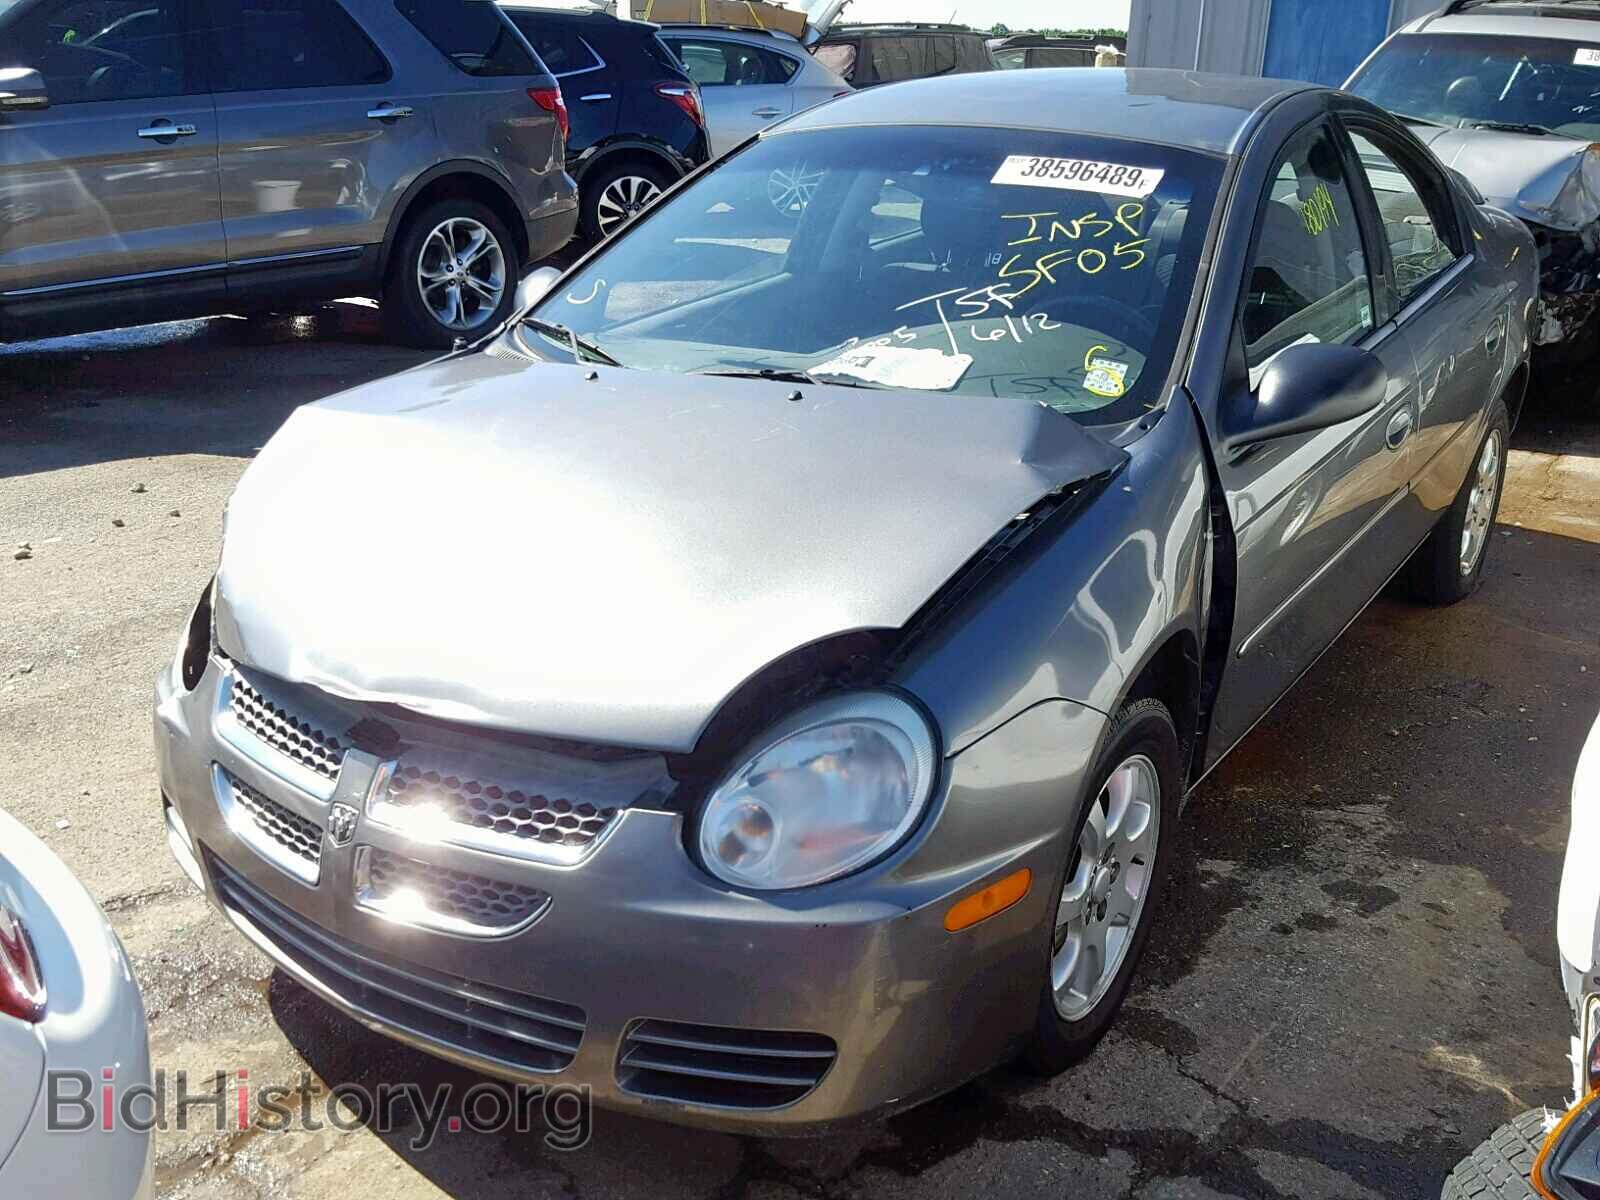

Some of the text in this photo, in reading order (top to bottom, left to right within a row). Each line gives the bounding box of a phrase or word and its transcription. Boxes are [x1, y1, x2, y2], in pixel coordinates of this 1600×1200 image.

[1020, 157, 1143, 188] 38596489
[1000, 202, 1144, 246] INSP
[970, 312, 1062, 344] 6/12
